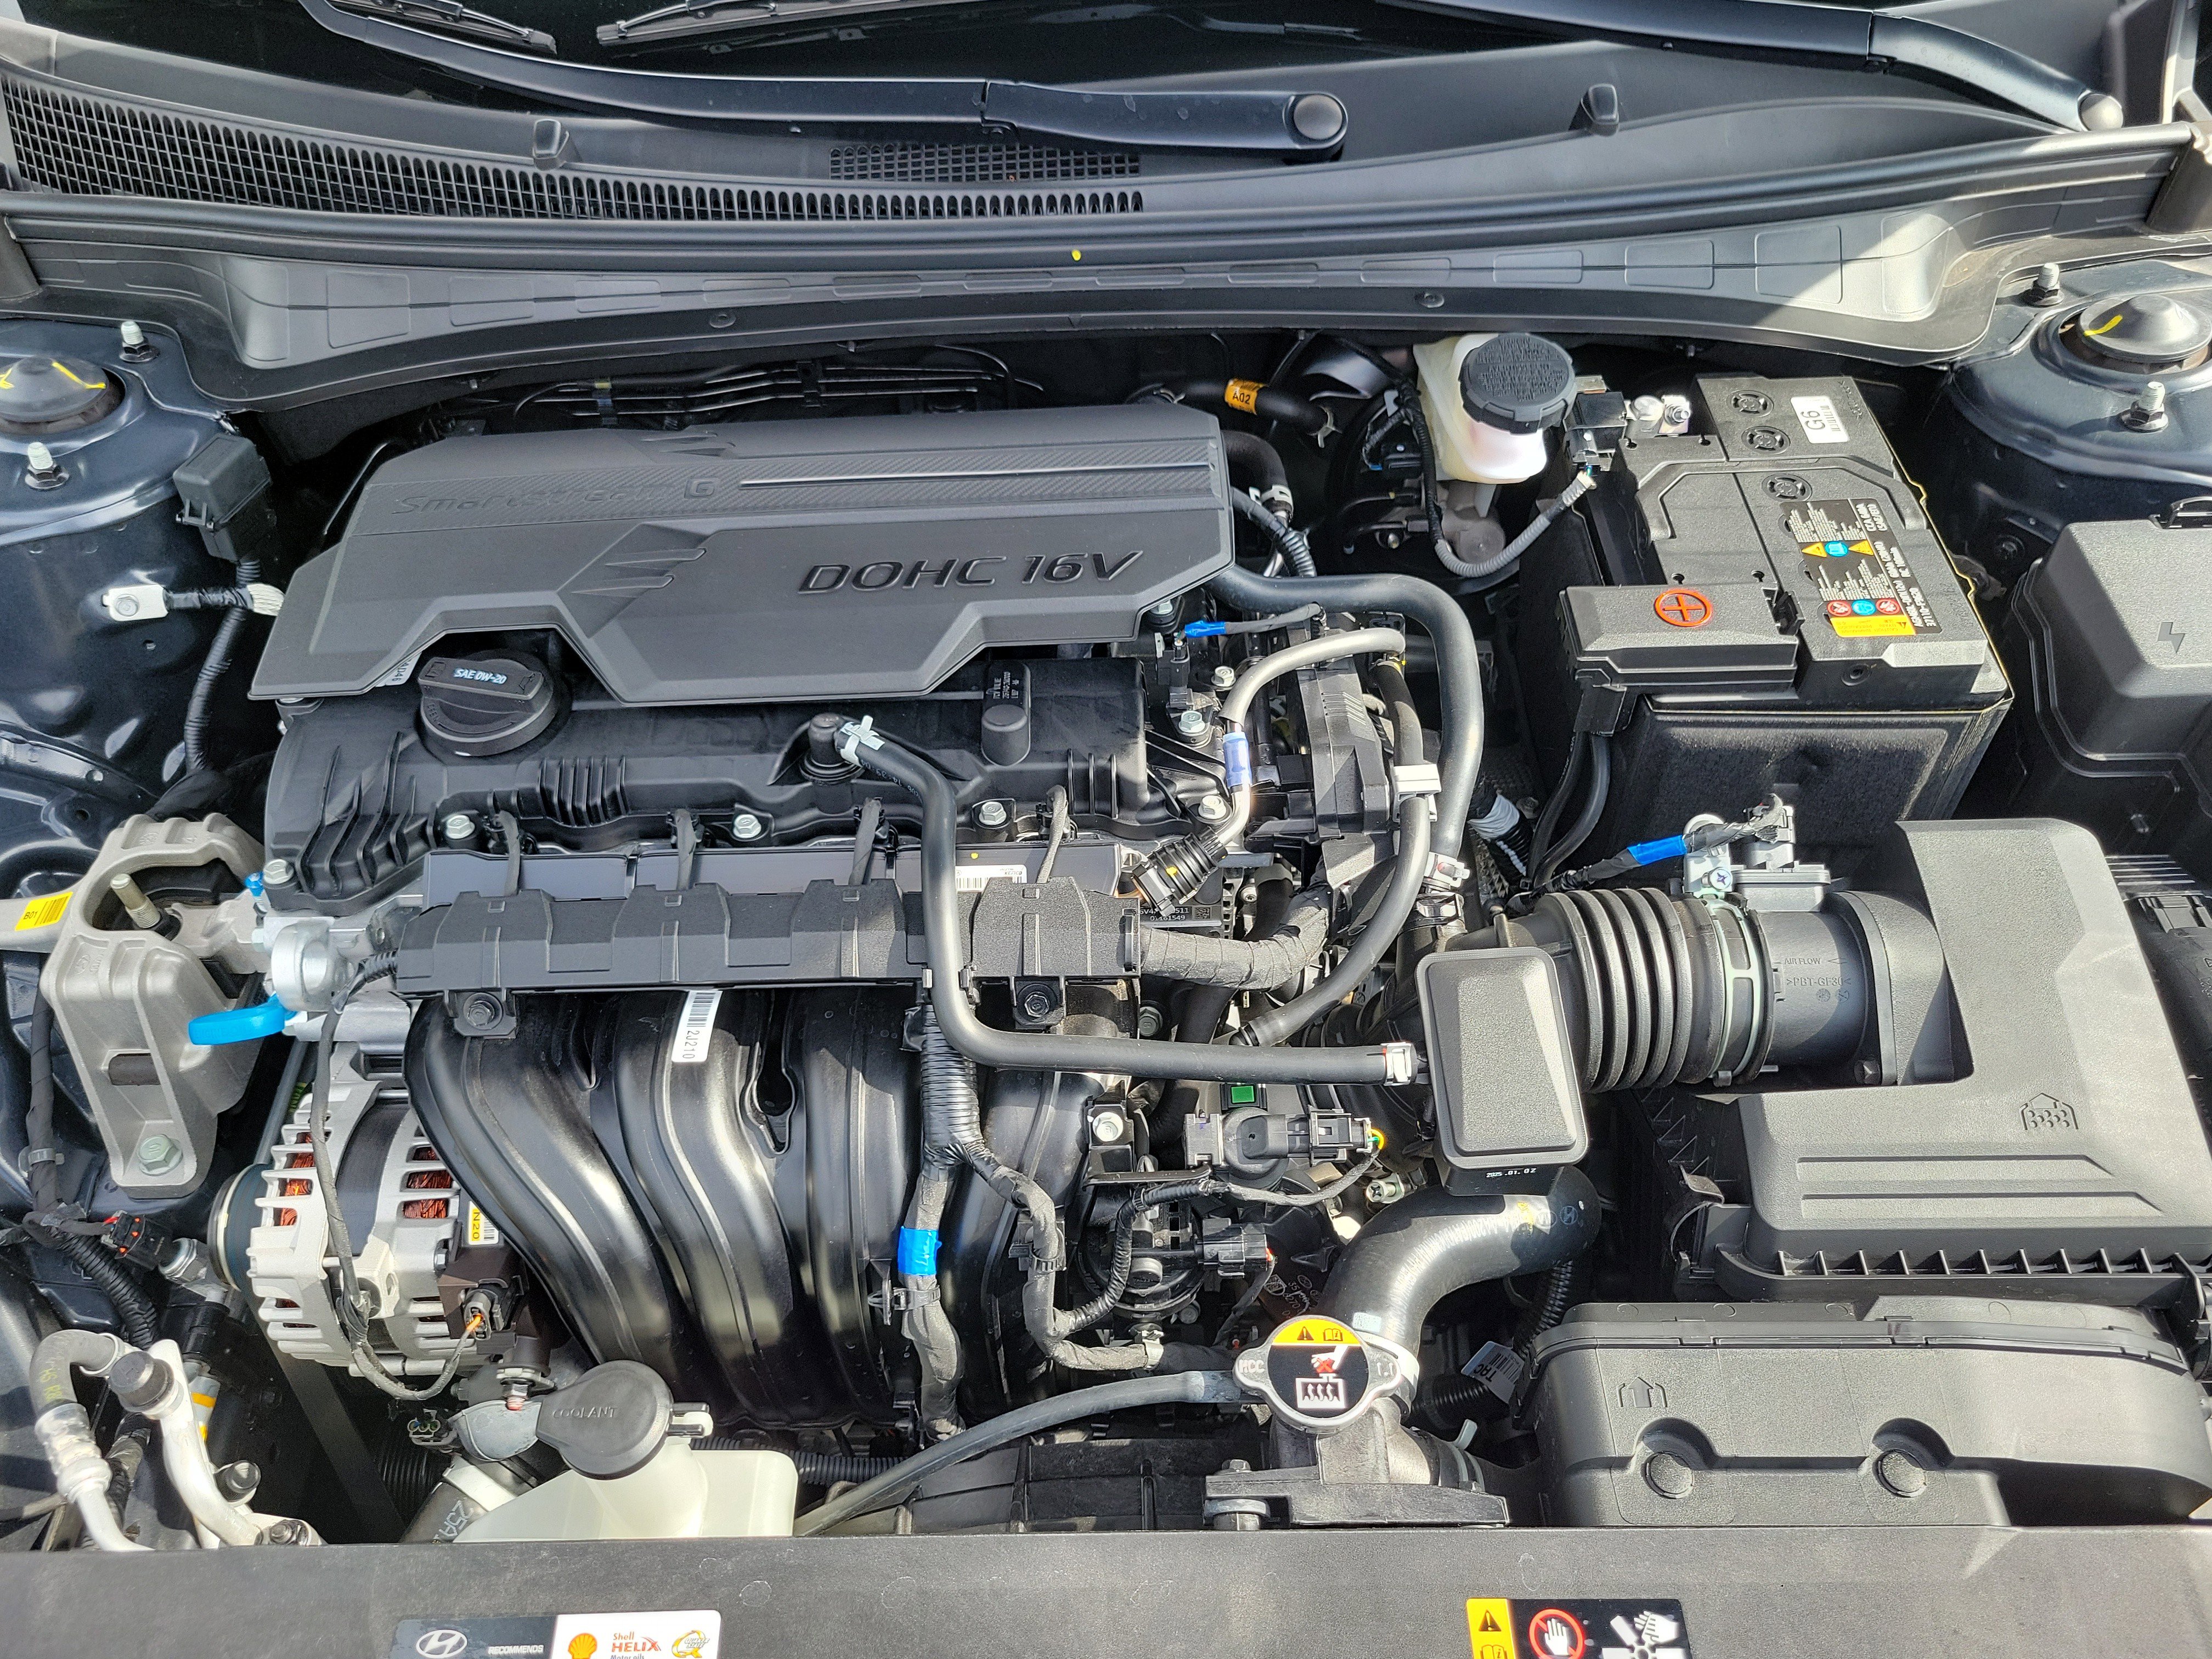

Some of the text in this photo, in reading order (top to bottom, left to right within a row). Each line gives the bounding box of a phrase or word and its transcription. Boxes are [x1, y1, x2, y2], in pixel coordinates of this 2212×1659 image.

[1232, 390, 1251, 405] A02
[1801, 410, 1825, 430] G6
[798, 550, 1143, 594] DOHC 16V
[453, 668, 507, 685] SAE 0W-20
[22, 910, 38, 922] B01
[682, 1030, 699, 1059] 2J210
[472, 1211, 481, 1240] N20
[1238, 1358, 1266, 1374] HCC
[1476, 1364, 1497, 1383] TAC
[552, 1405, 619, 1420] COOLANT
[613, 1631, 635, 1640] Shell
[487, 1645, 545, 1655] RECOMMENDS
[611, 1640, 660, 1652] HELIX
